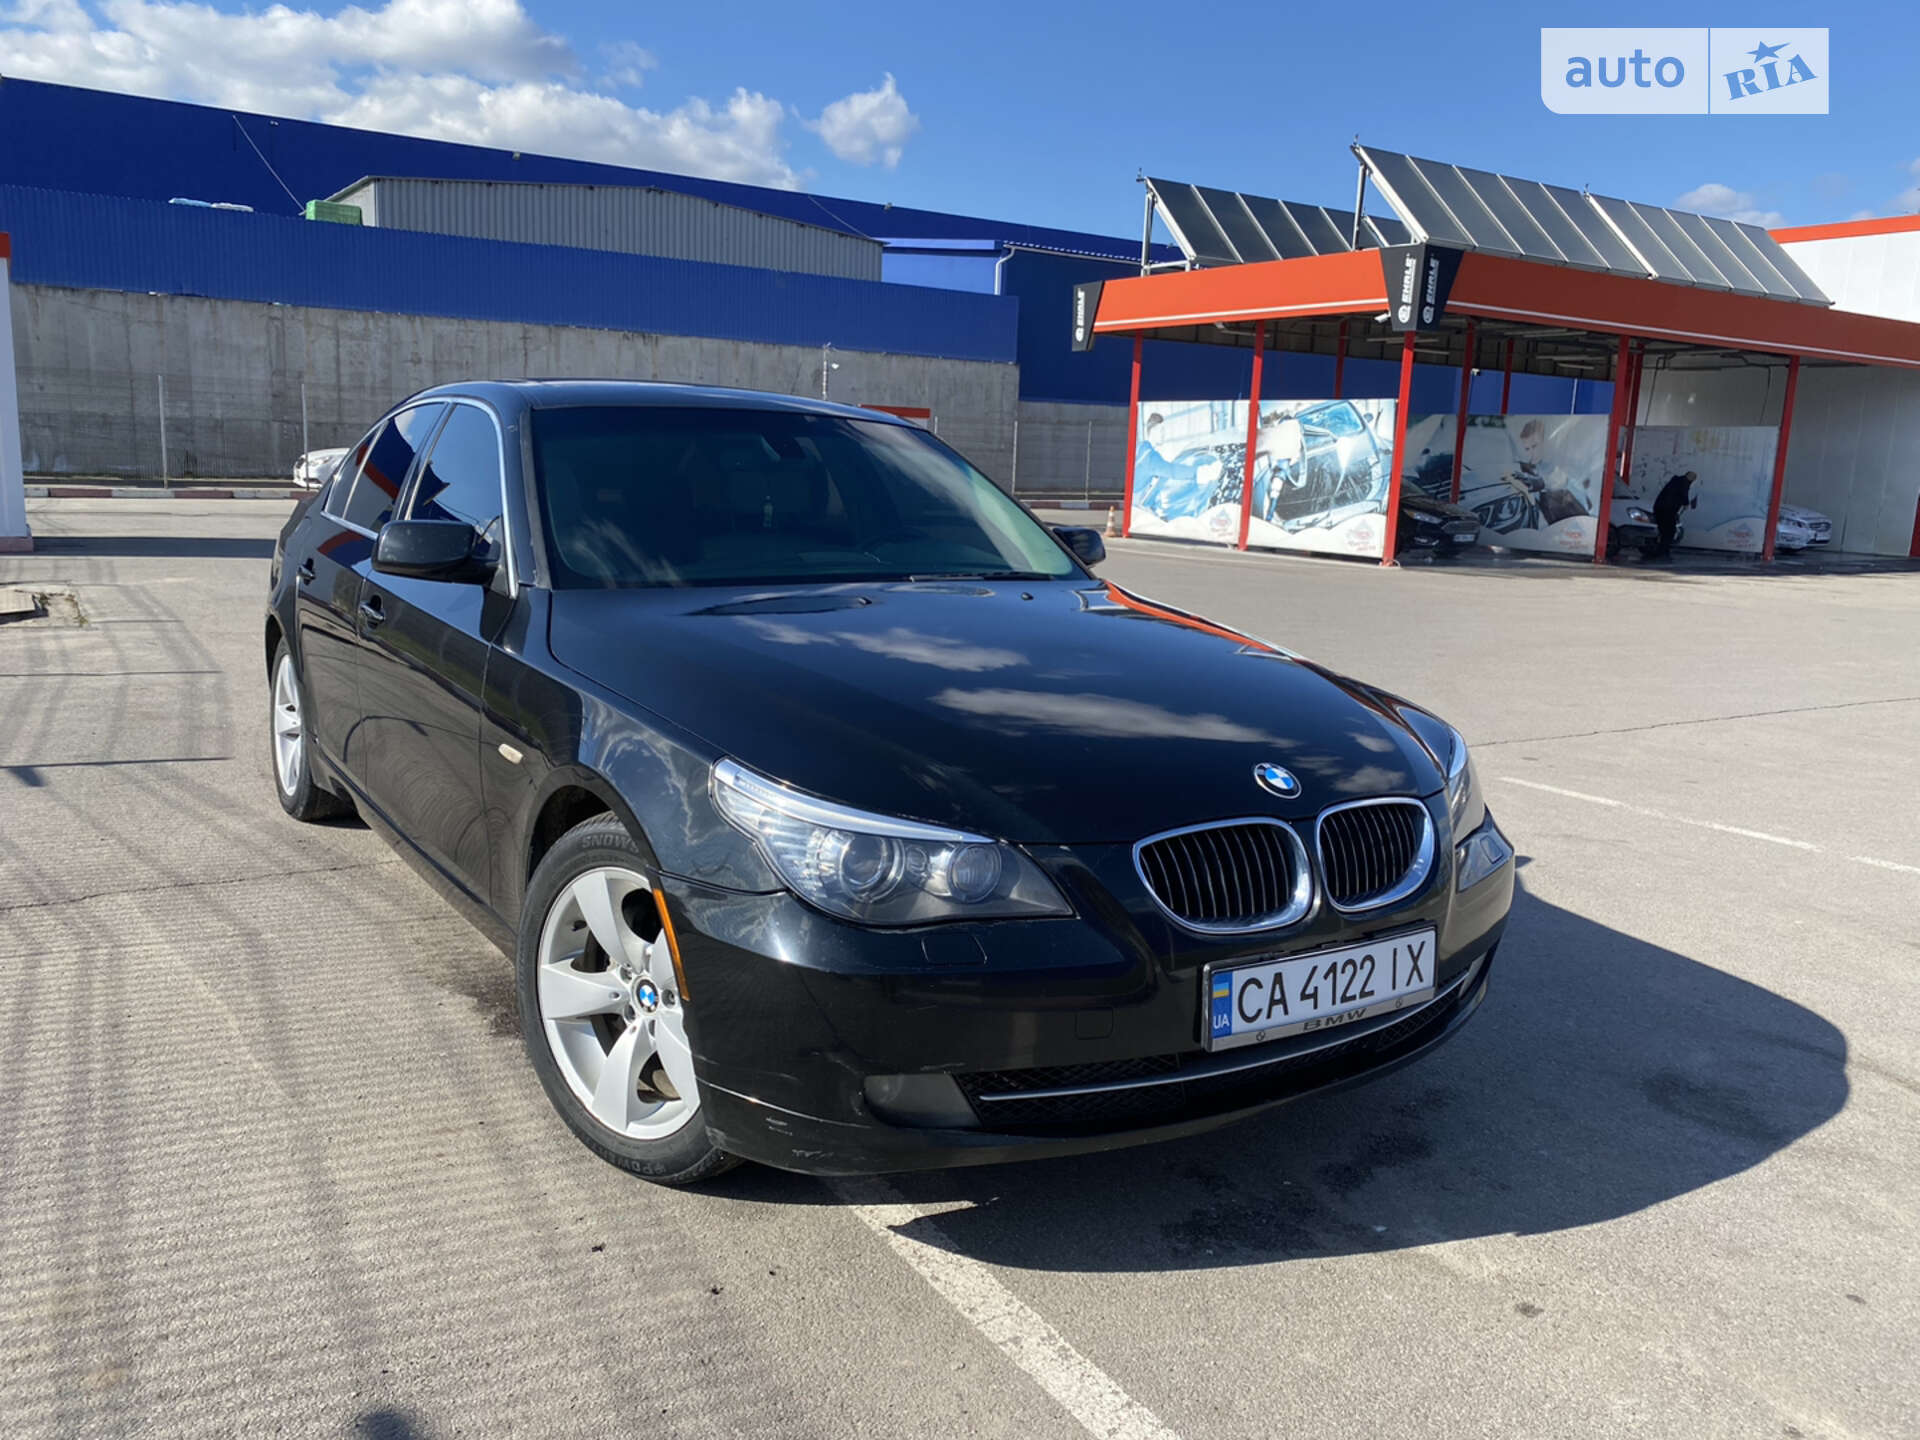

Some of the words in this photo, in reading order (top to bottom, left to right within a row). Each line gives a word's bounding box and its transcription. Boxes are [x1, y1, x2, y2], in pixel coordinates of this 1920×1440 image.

[1237, 971, 1289, 1024] CA
[1299, 954, 1376, 1010] 4122
[1391, 940, 1426, 991] IX
[1212, 1013, 1230, 1030] UA
[1303, 1007, 1367, 1032] BMW
